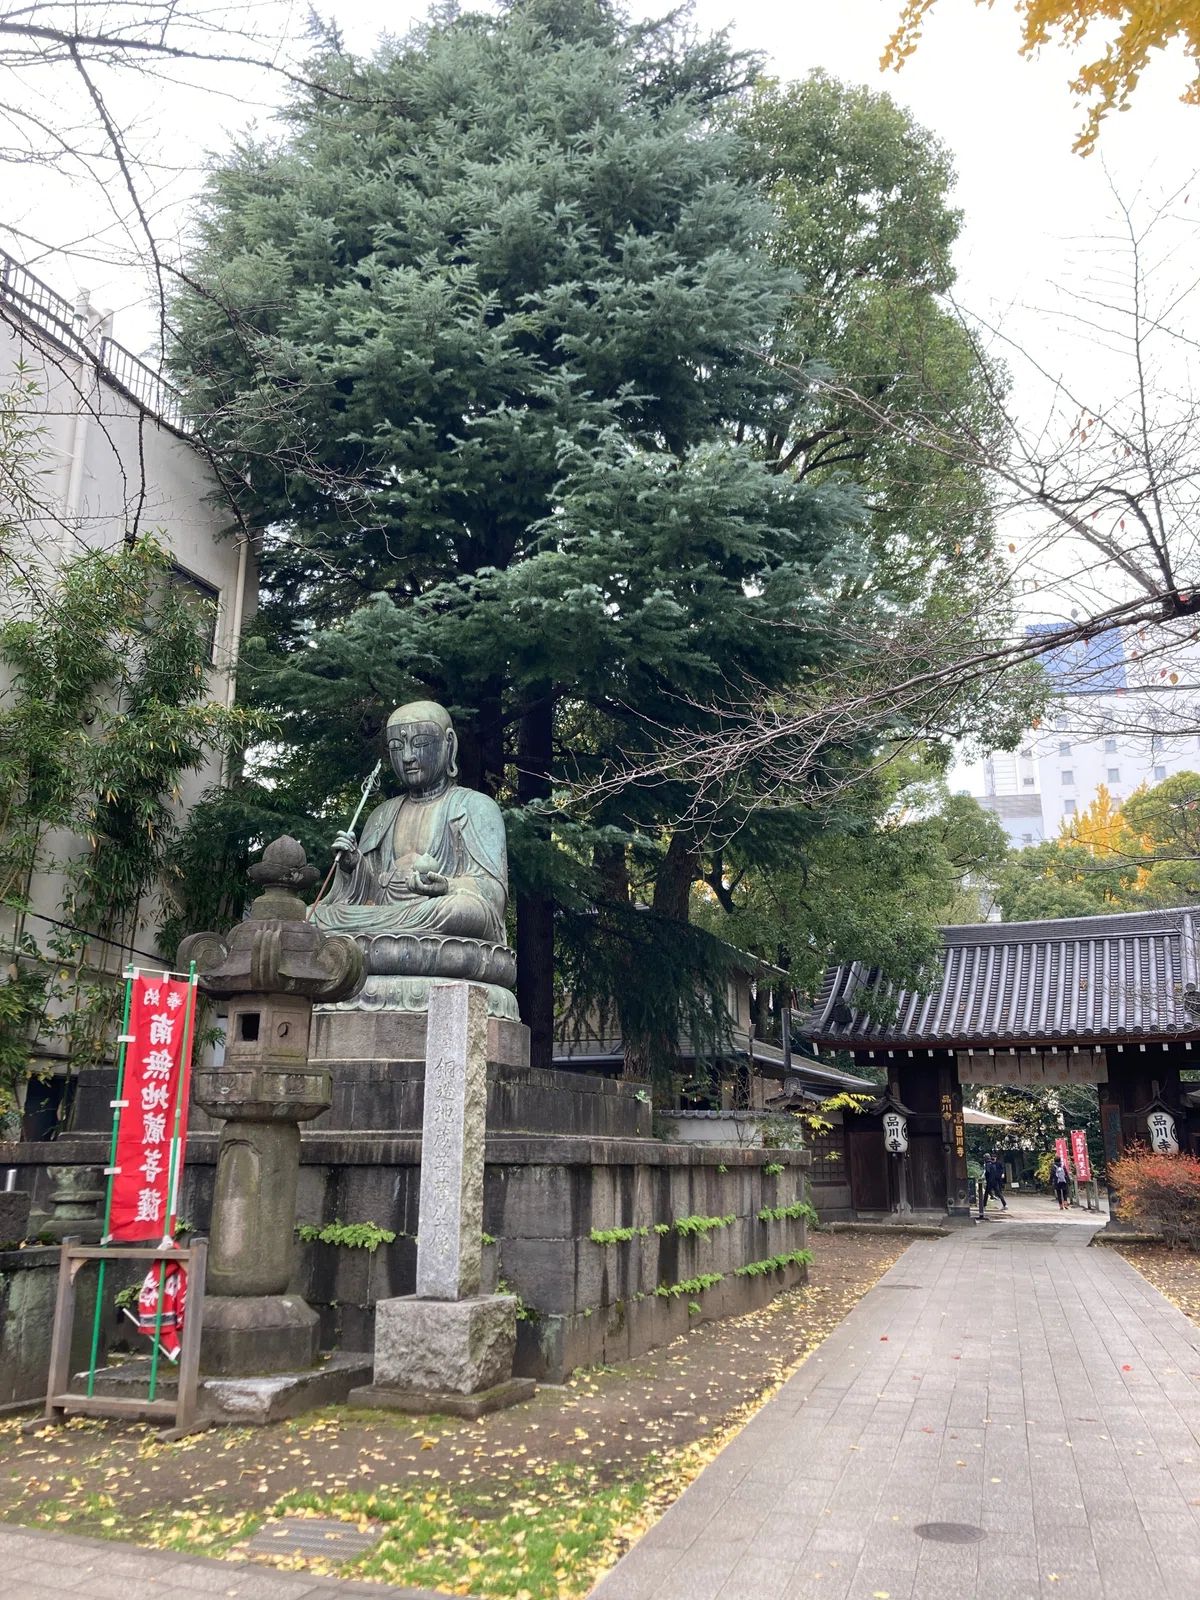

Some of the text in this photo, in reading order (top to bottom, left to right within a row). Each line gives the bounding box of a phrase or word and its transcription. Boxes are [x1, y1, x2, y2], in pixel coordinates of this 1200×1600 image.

[886, 1116, 902, 1151] 品川寺
[1152, 1114, 1172, 1153] 品川寺
